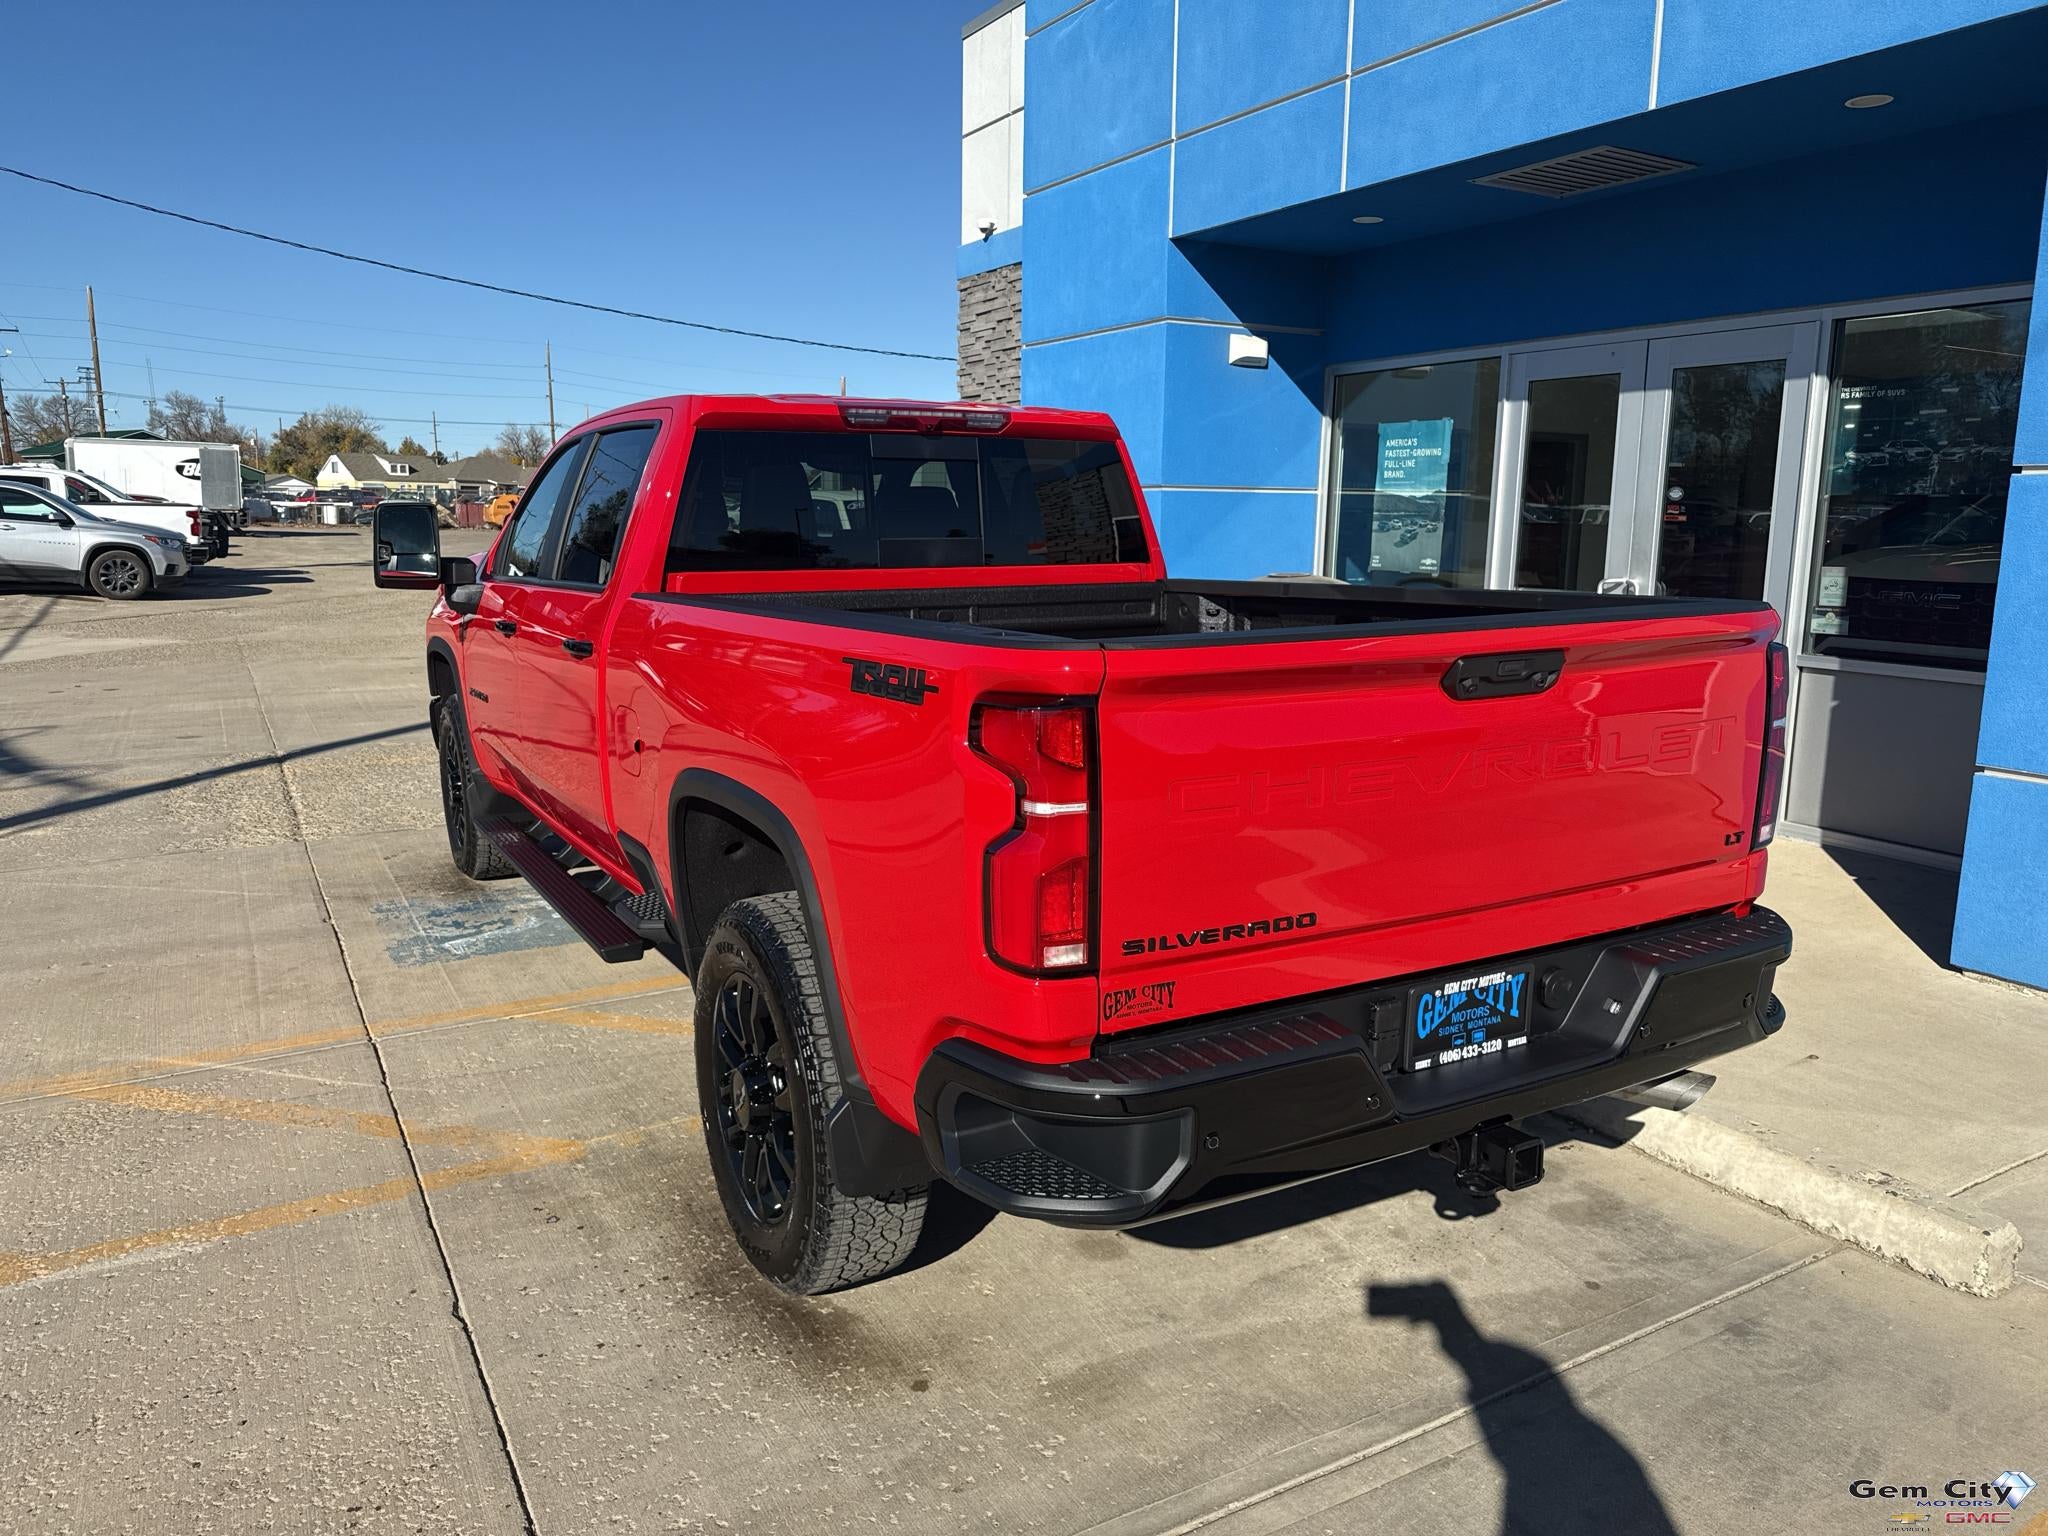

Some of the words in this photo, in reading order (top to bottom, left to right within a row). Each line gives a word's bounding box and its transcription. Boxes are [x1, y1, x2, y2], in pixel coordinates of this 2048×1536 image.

[1851, 391, 1875, 399] FAMILY
[1385, 438, 1418, 448] AMERICA'S
[1384, 448, 1442, 458] FASTEST-GROWING
[1384, 459, 1416, 468] FULL-LINE
[1383, 470, 1406, 479] BRAND.
[1879, 591, 1960, 609] GMC
[1168, 715, 1738, 821] CHEVROLET
[1724, 831, 1745, 846] LT
[1121, 912, 1318, 957] SILVERADO
[1444, 981, 1460, 995] GEM
[1460, 977, 1478, 991] CITY
[1478, 971, 1506, 988] MOTORS
[1103, 987, 1137, 1021] GEM
[1142, 981, 1176, 1009] CITY
[1451, 1005, 1490, 1023] MOTORS
[1467, 1015, 1501, 1030] MONTANA
[1462, 1038, 1502, 1058] 433-3120
